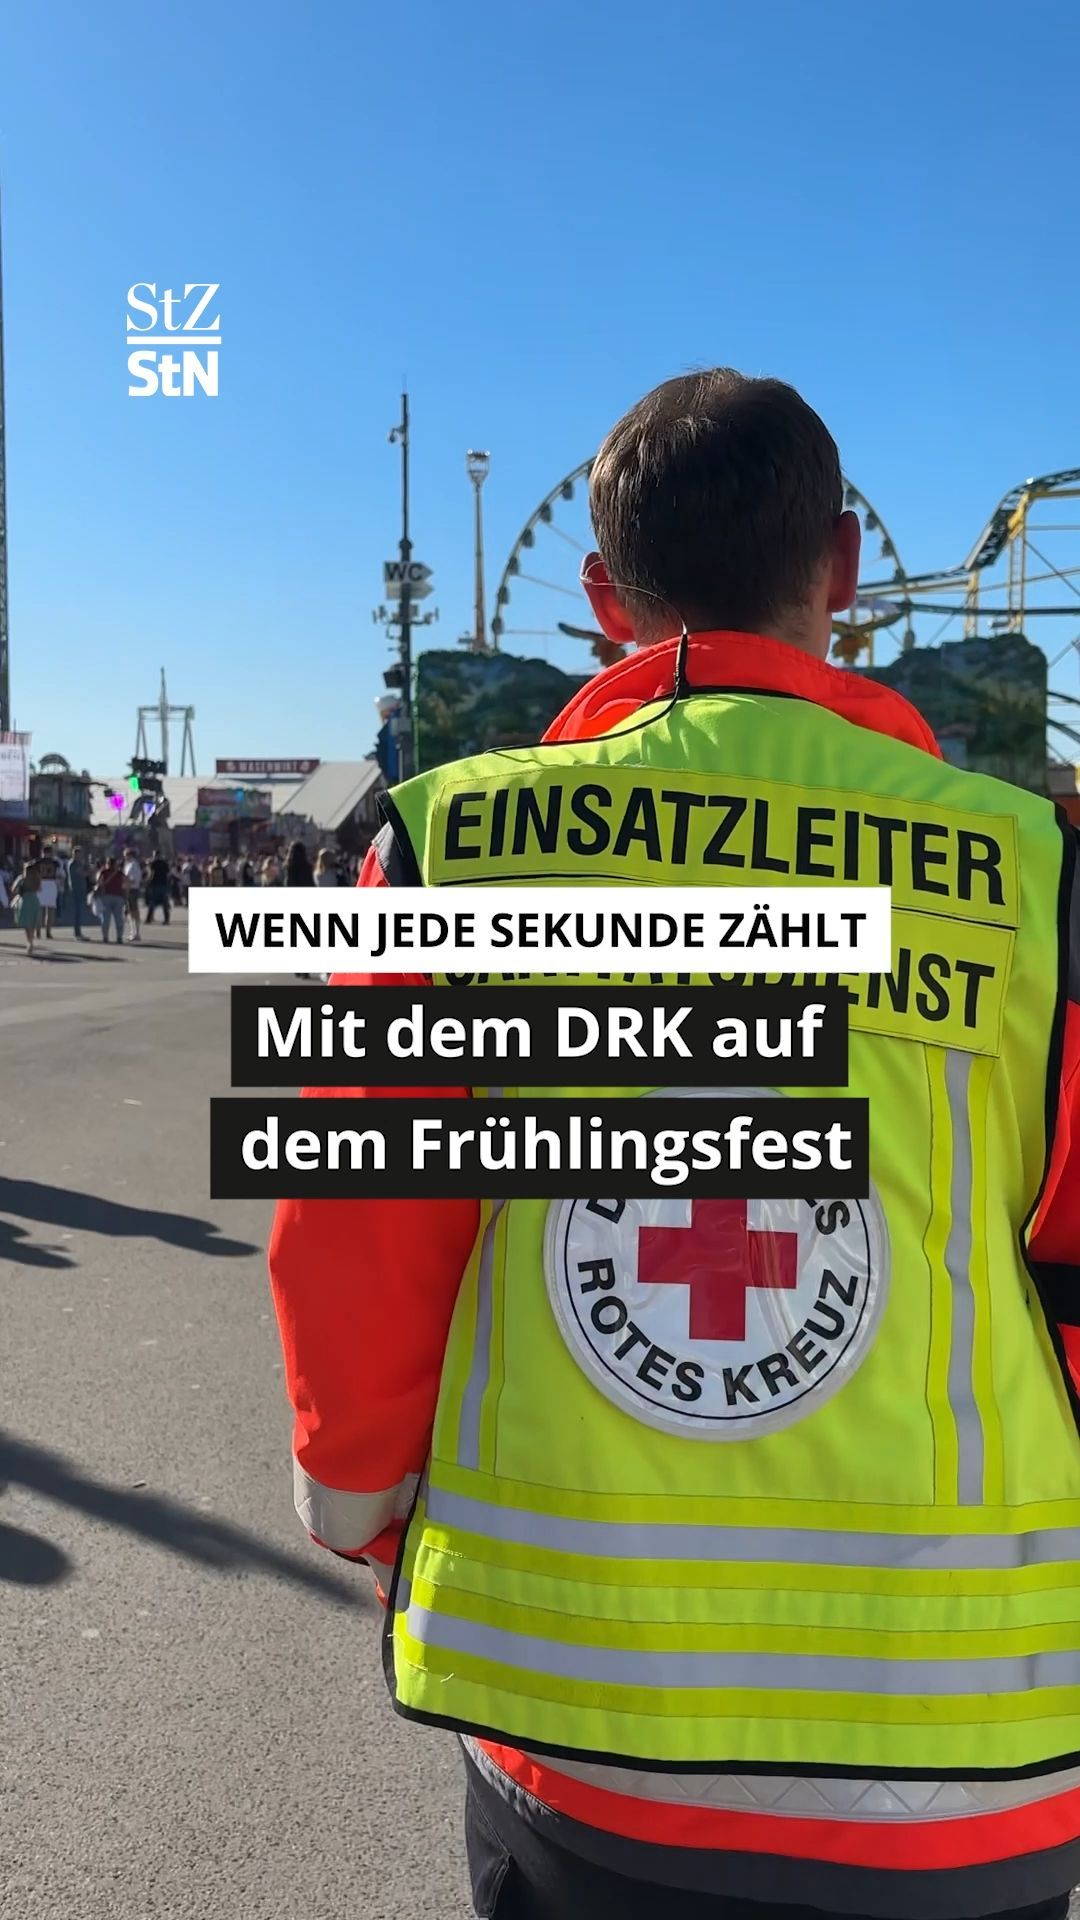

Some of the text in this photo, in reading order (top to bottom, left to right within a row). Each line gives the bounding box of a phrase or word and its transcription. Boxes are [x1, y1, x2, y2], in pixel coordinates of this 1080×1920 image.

[384, 562, 423, 581] WC
[444, 783, 1006, 906] EINSATZLEITER
[577, 1257, 859, 1406] ROTES KREUZ
